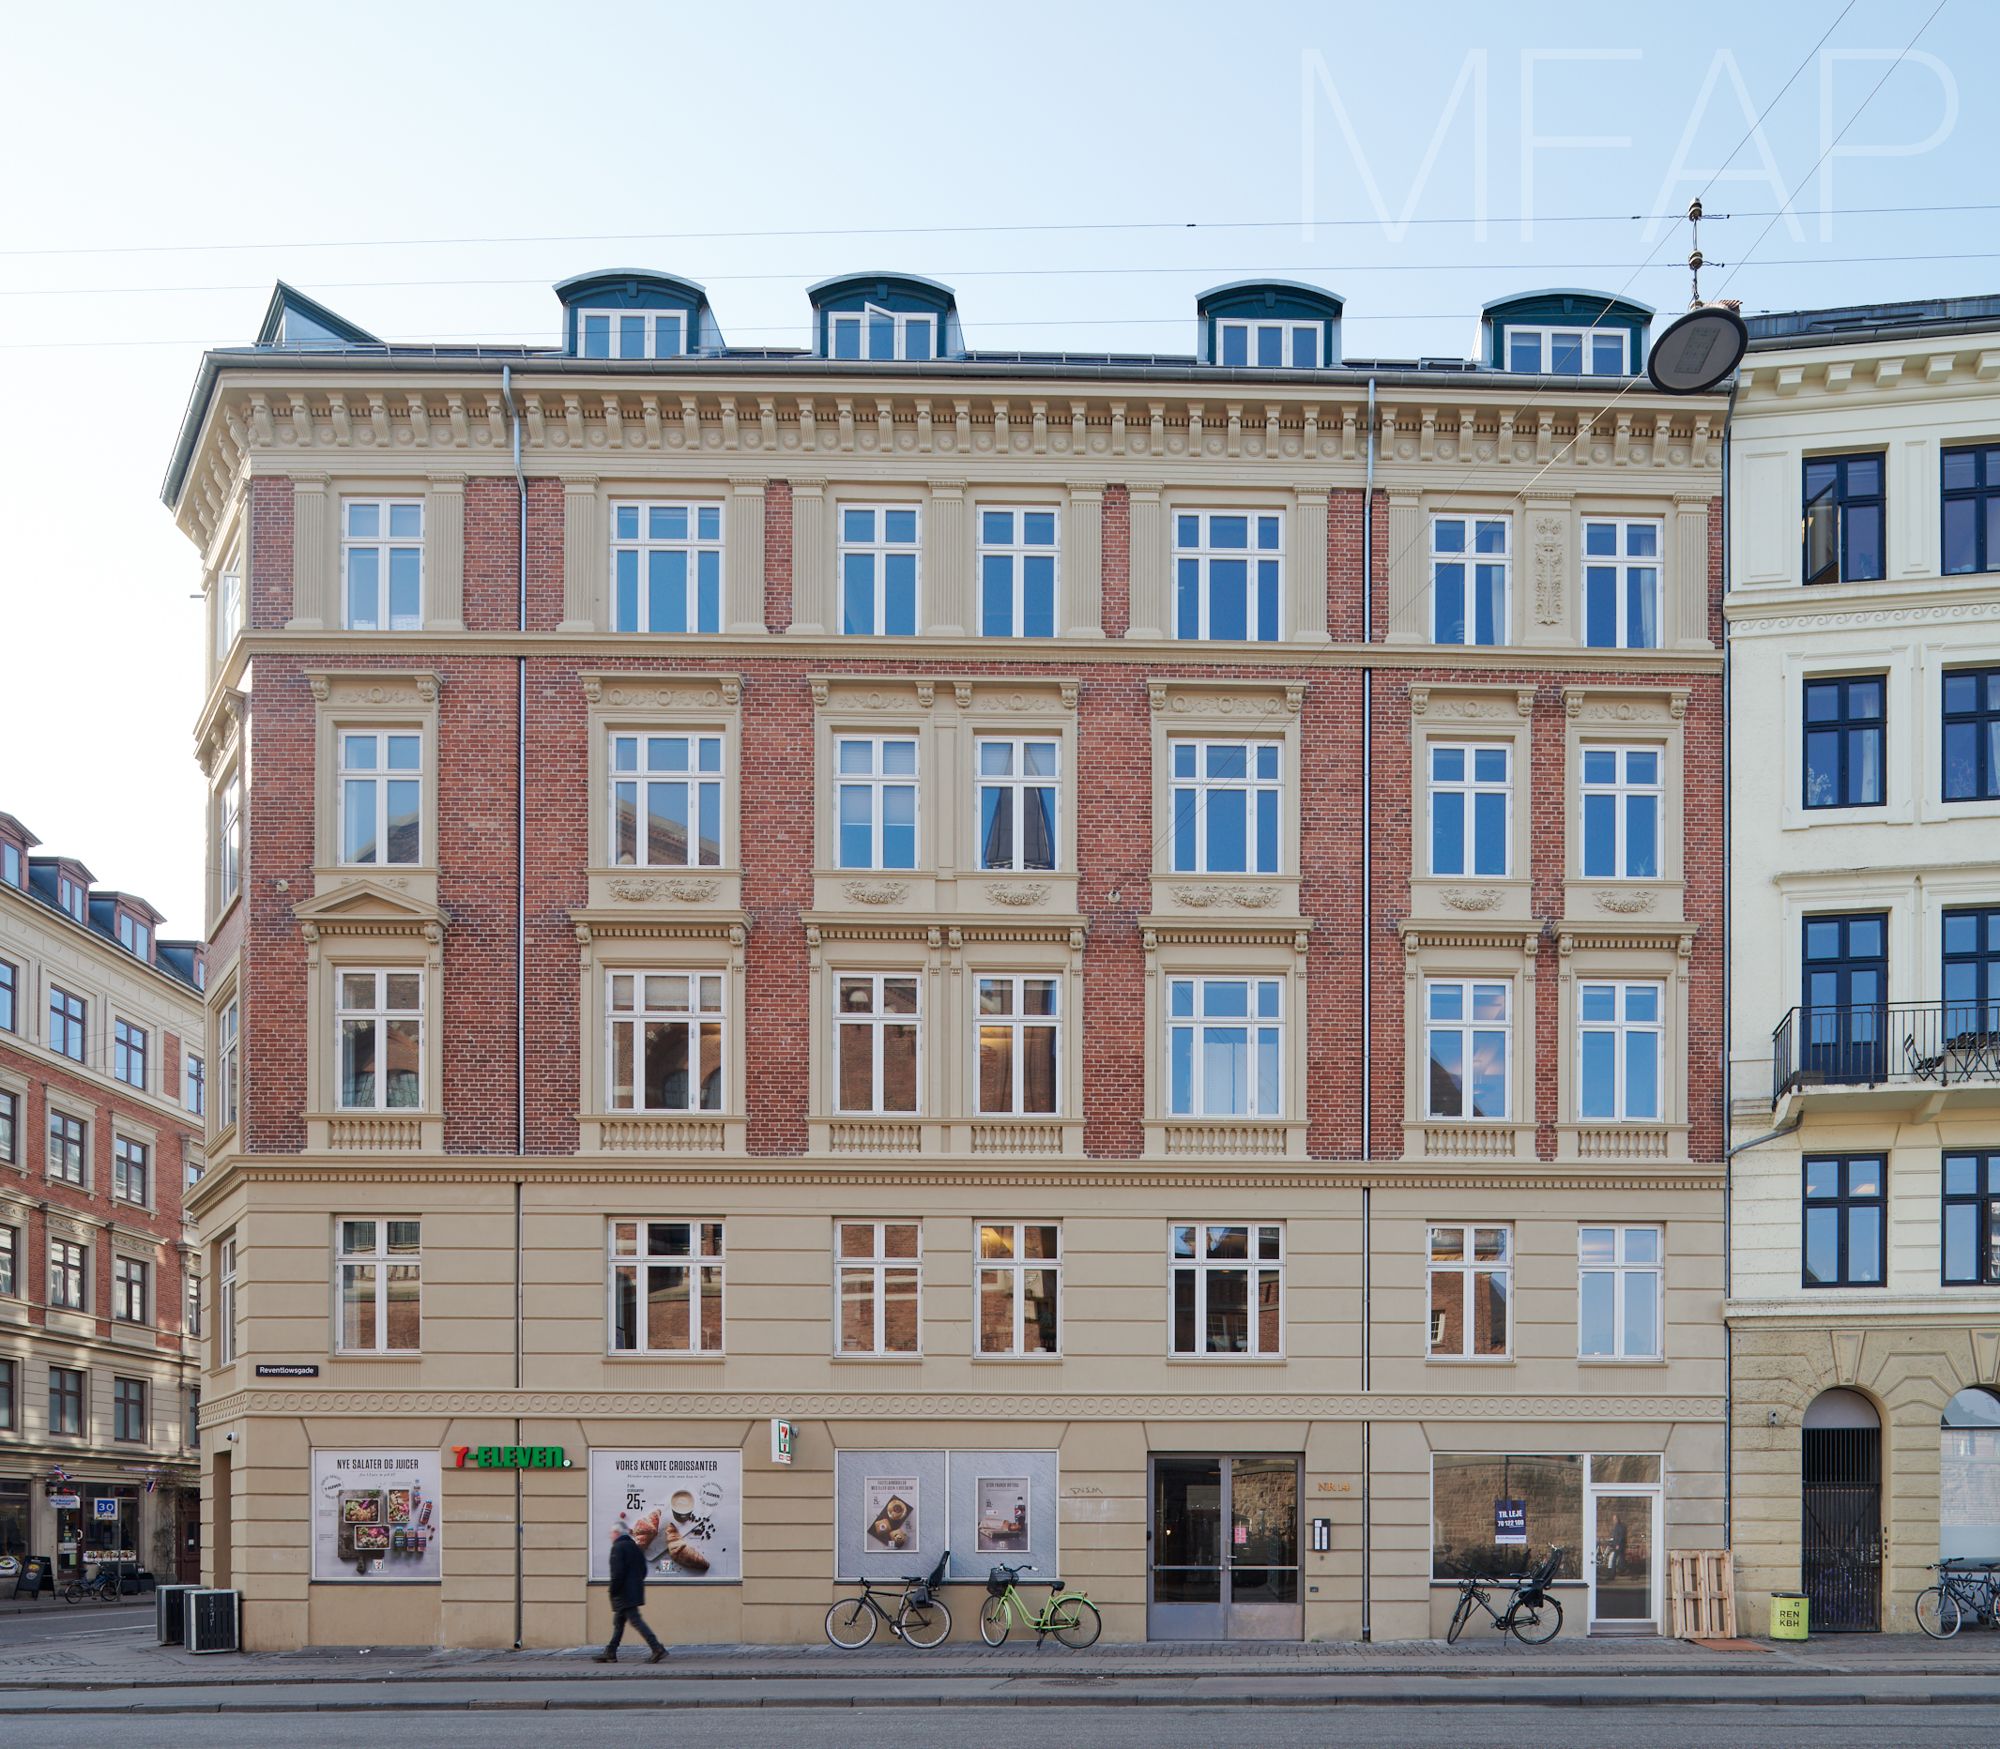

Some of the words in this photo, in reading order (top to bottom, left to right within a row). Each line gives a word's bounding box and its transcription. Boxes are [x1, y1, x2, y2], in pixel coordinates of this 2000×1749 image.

[259, 1366, 315, 1376] Reventlowsgade
[336, 1459, 350, 1470] NYE
[352, 1459, 382, 1470] SALATER
[384, 1459, 393, 1470] OG
[395, 1459, 419, 1470] JUICER
[615, 1460, 639, 1471] VORES
[640, 1460, 667, 1471] KENDTE
[669, 1460, 718, 1471] CROISSANTER
[98, 1503, 114, 1511] 30
[1508, 1510, 1523, 1518] LEJE
[1780, 1610, 1800, 1618] REN
[1780, 1619, 1800, 1627] KBH
